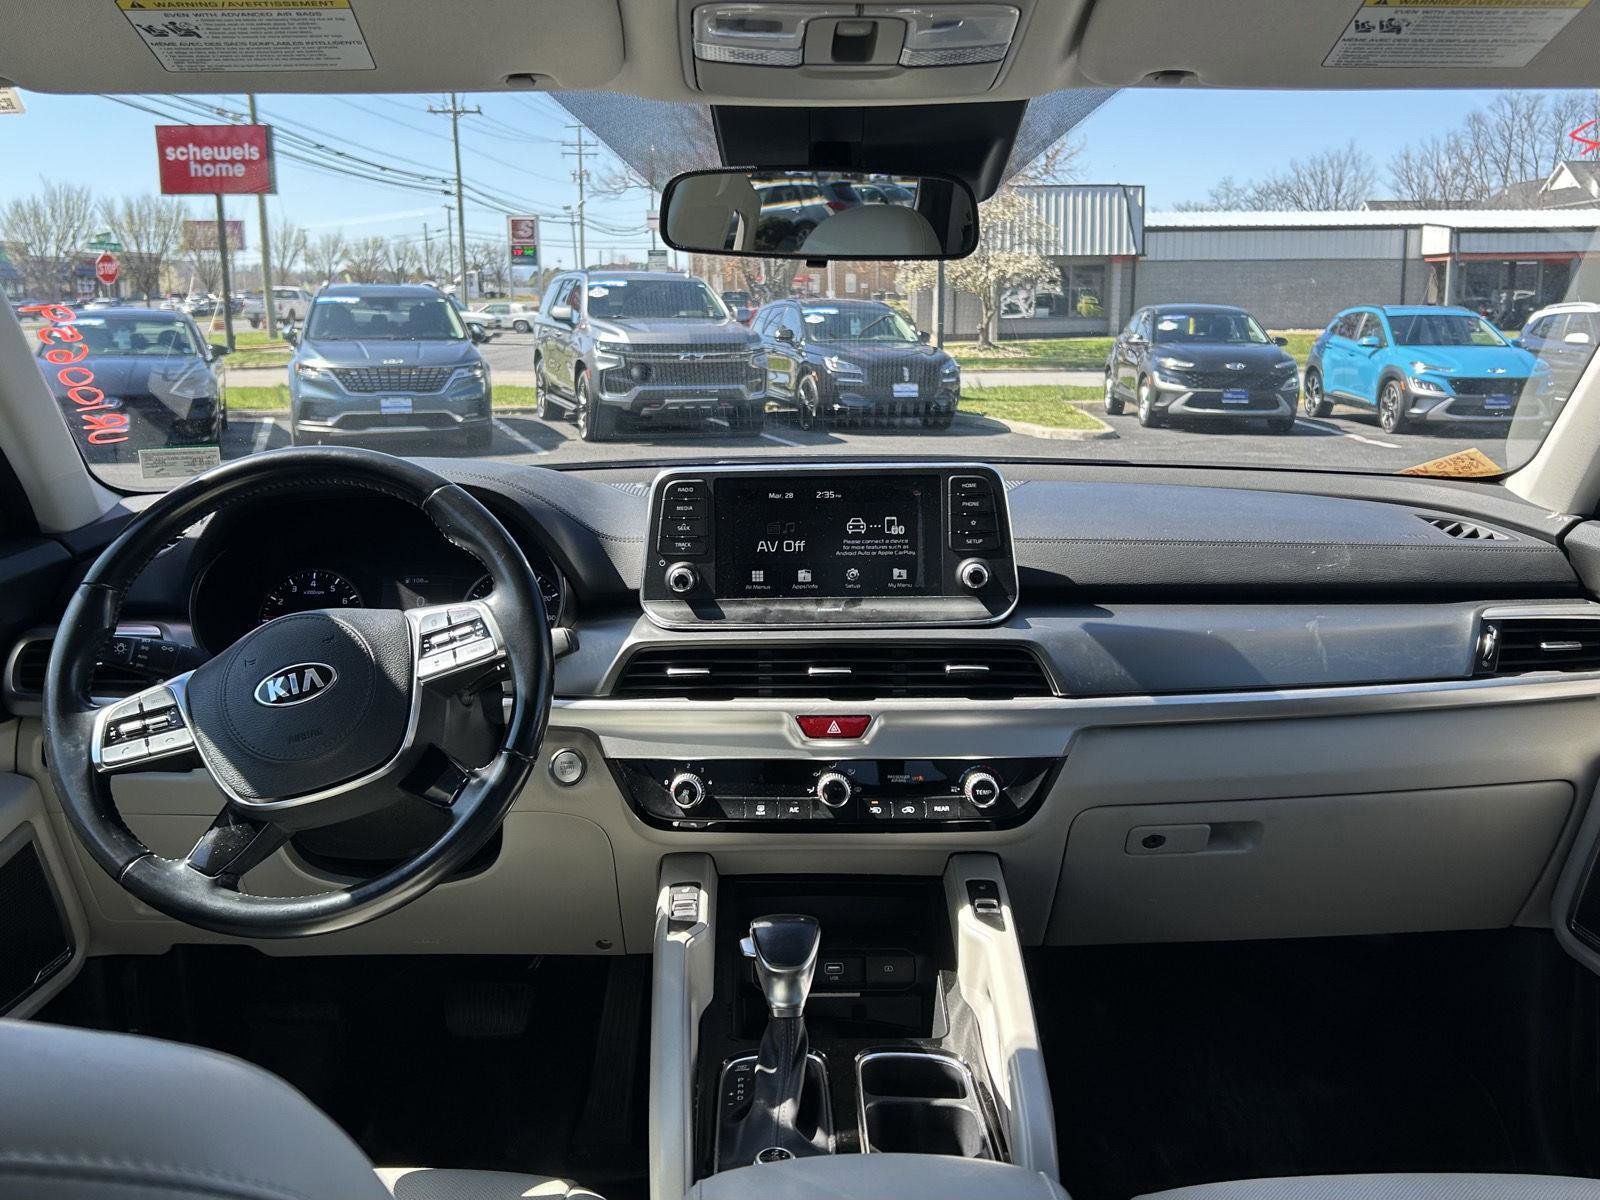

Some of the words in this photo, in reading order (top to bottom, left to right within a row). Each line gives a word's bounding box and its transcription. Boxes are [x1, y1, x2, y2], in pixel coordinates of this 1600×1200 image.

[165, 142, 260, 161] schewels
[189, 160, 246, 177] home
[816, 491, 835, 499] 2:35
[756, 540, 779, 553] AV
[783, 540, 806, 552] Off
[266, 667, 325, 703] KIA
[975, 788, 992, 796] TEMP
[933, 804, 950, 812] REAR
